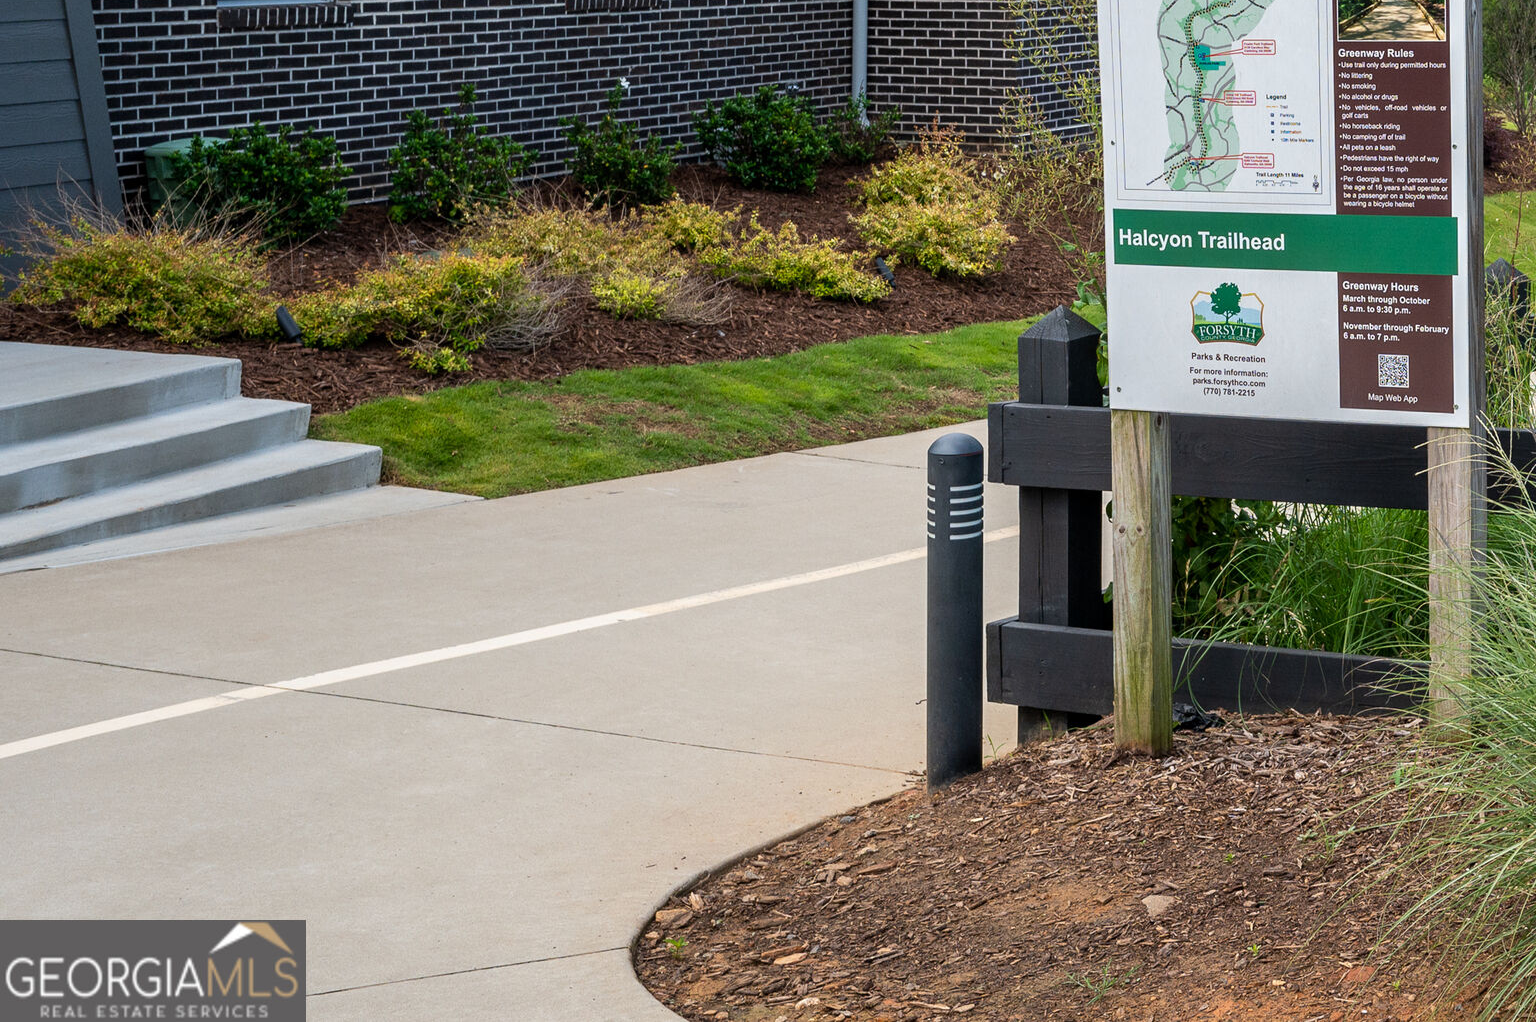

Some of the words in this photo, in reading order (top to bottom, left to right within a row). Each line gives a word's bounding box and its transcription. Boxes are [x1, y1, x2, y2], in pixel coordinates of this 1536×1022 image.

[1338, 49, 1385, 59] Greenway
[1387, 49, 1414, 57] Rules
[1119, 229, 1192, 251] Halcyon
[1198, 231, 1285, 251] Trailhead
[1343, 281, 1388, 293] Greenway
[1391, 282, 1419, 292] Hours
[1368, 296, 1397, 305] through
[1200, 325, 1256, 338] FORSYTH
[1344, 322, 1382, 330] November
[1384, 324, 1413, 333] through
[1415, 325, 1449, 334] February
[1224, 354, 1265, 362] Recreation
[1224, 369, 1268, 377] information:
[1193, 378, 1265, 387] parks.forsythco.com
[1368, 393, 1383, 402] Map
[1385, 394, 1401, 402] Web
[1403, 395, 1418, 404] App
